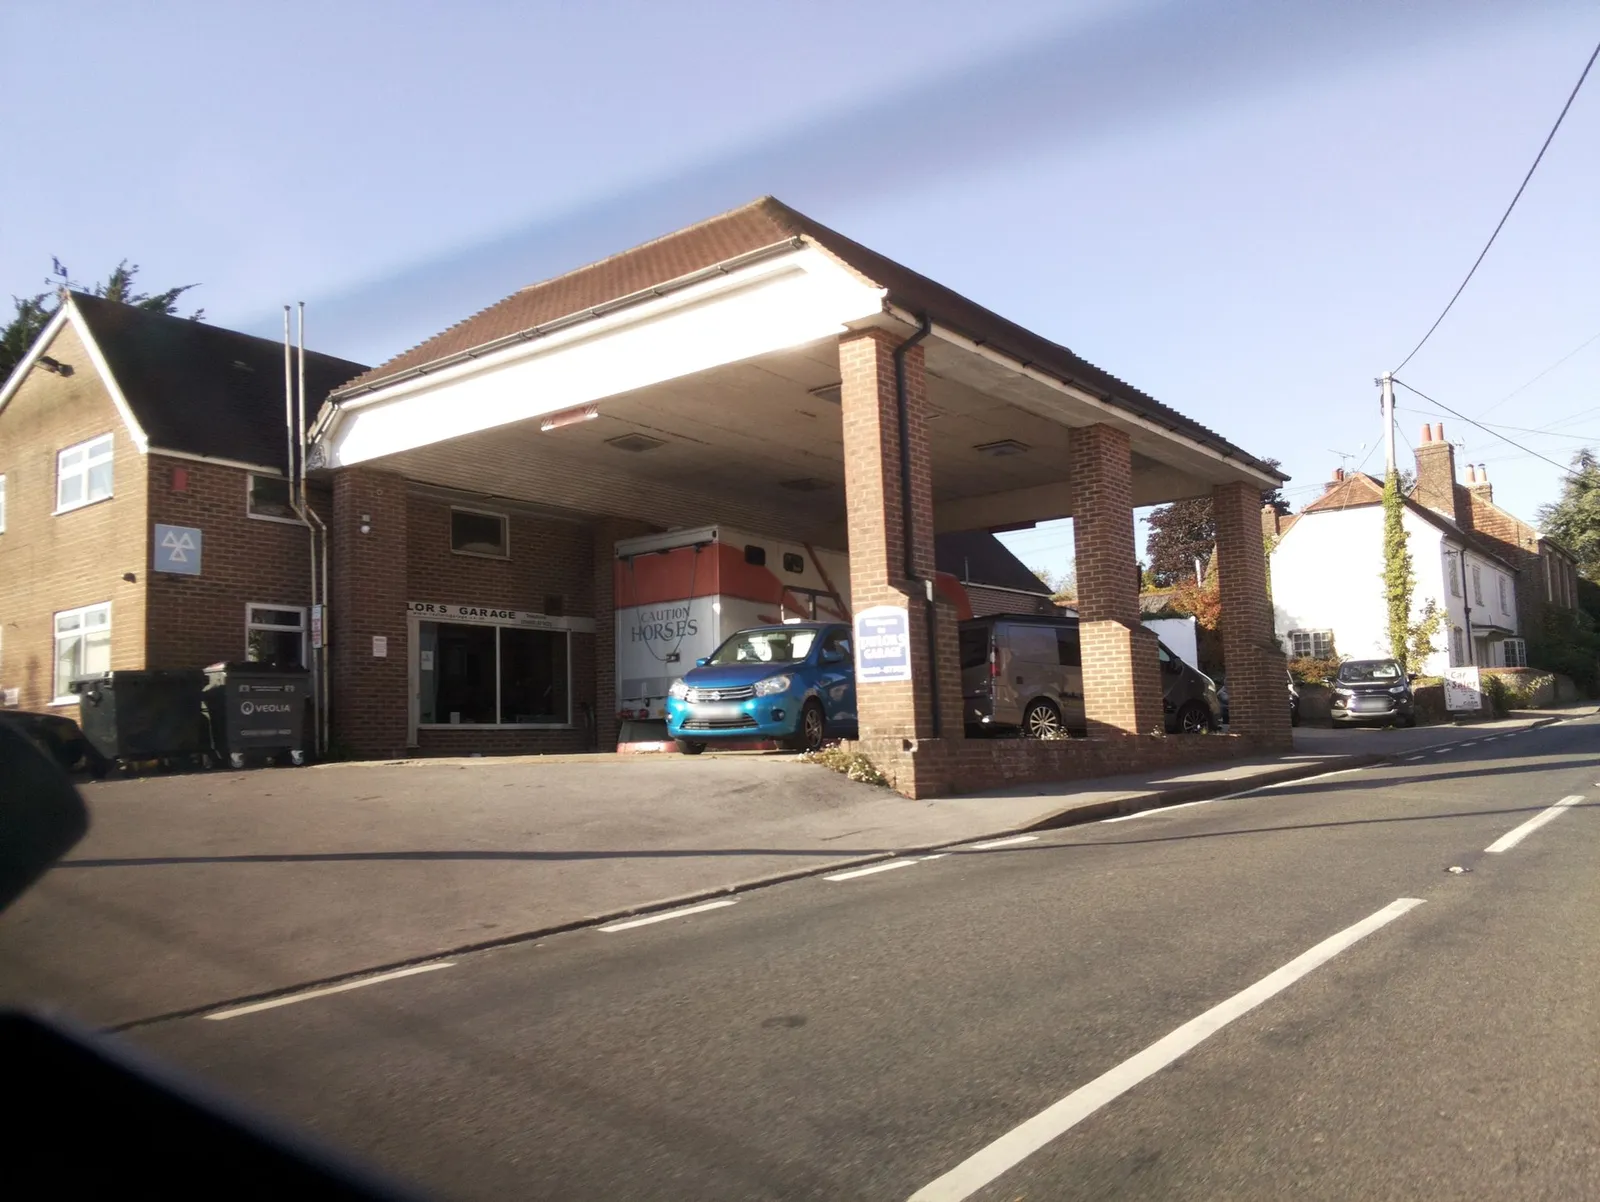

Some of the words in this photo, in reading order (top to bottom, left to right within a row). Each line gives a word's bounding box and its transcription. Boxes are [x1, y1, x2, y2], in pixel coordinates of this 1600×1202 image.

[459, 607, 516, 619] GARAGE
[640, 606, 690, 622] CAUTION
[631, 619, 698, 642] HORSES
[864, 646, 902, 659] GARAGE
[1450, 671, 1466, 679] Car
[1452, 680, 1476, 688] Sales
[255, 704, 291, 712] VEOLIA
